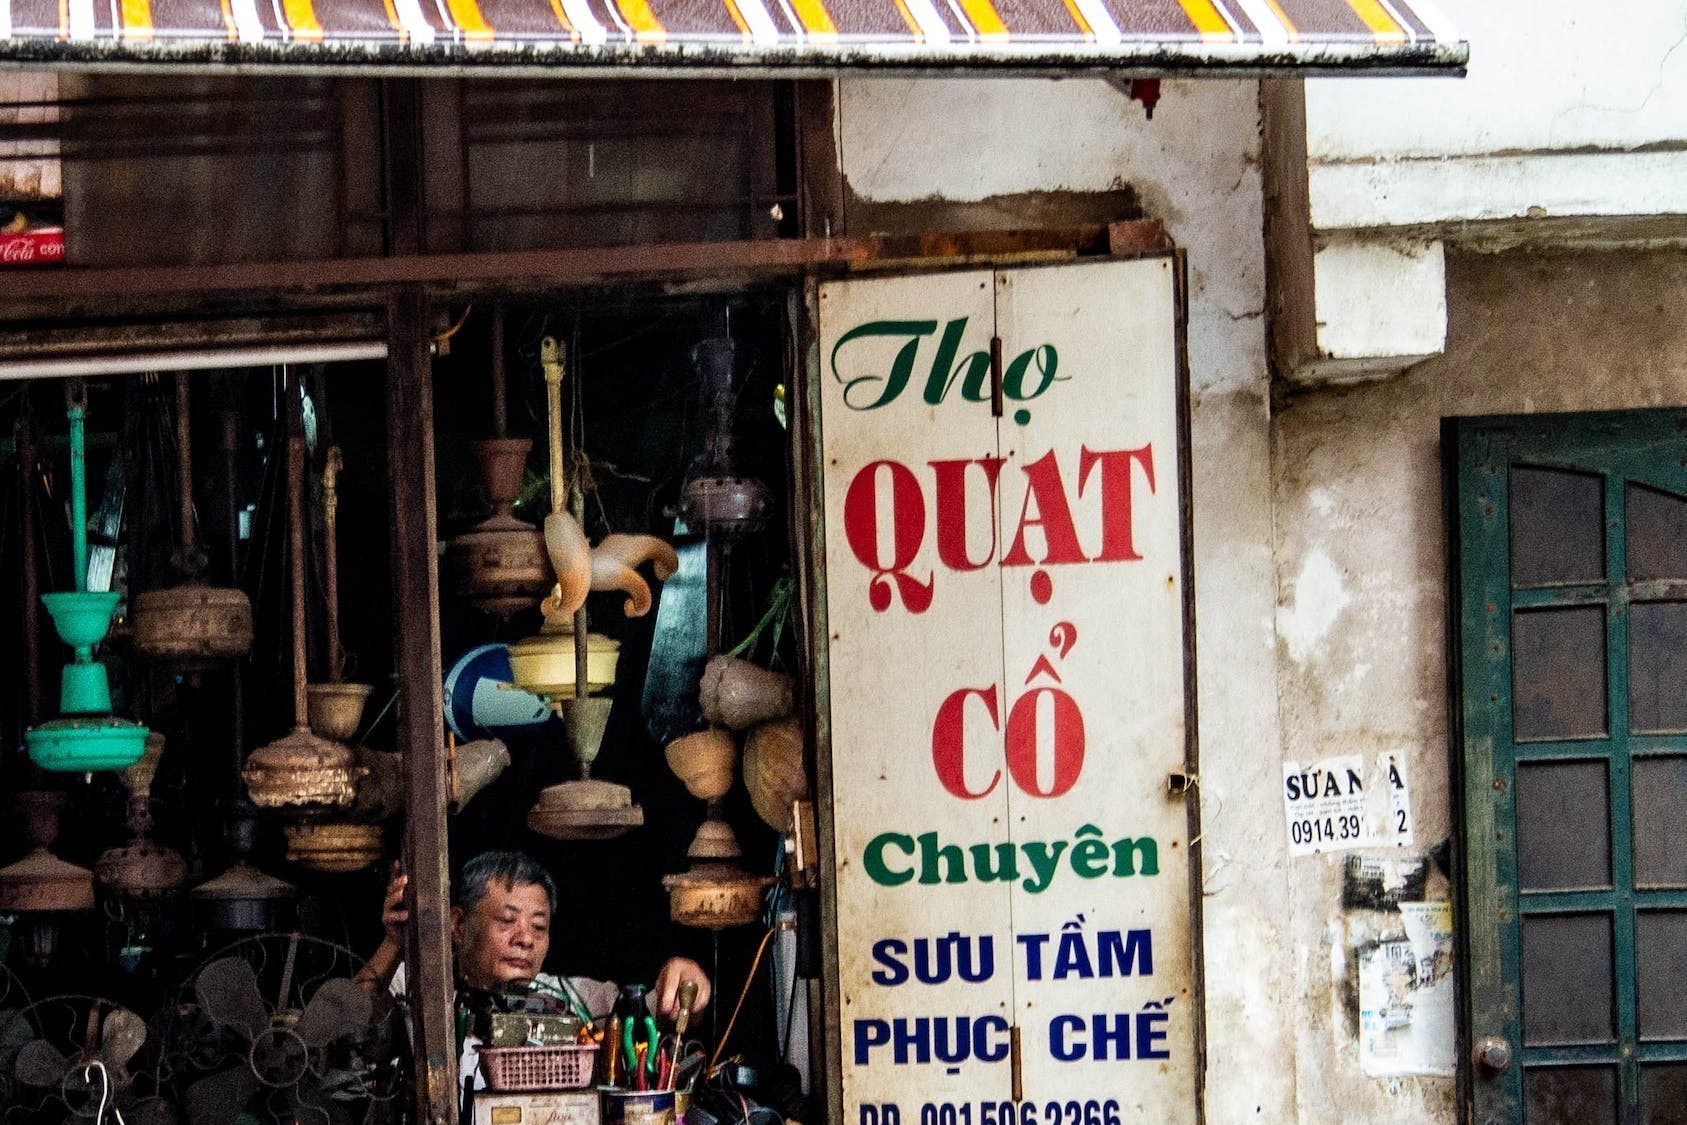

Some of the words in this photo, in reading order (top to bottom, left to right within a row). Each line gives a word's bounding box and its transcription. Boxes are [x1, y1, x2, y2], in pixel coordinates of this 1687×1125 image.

[831, 316, 1072, 426] Thọ
[844, 442, 1156, 615] QUẠT
[932, 621, 1086, 801] CỔ
[863, 823, 1160, 893] Chuyên
[871, 931, 995, 987] SƯU
[1016, 913, 1154, 981] TẦM
[853, 1014, 1010, 1076] PHỤC
[1049, 997, 1175, 1062] CHẾ
